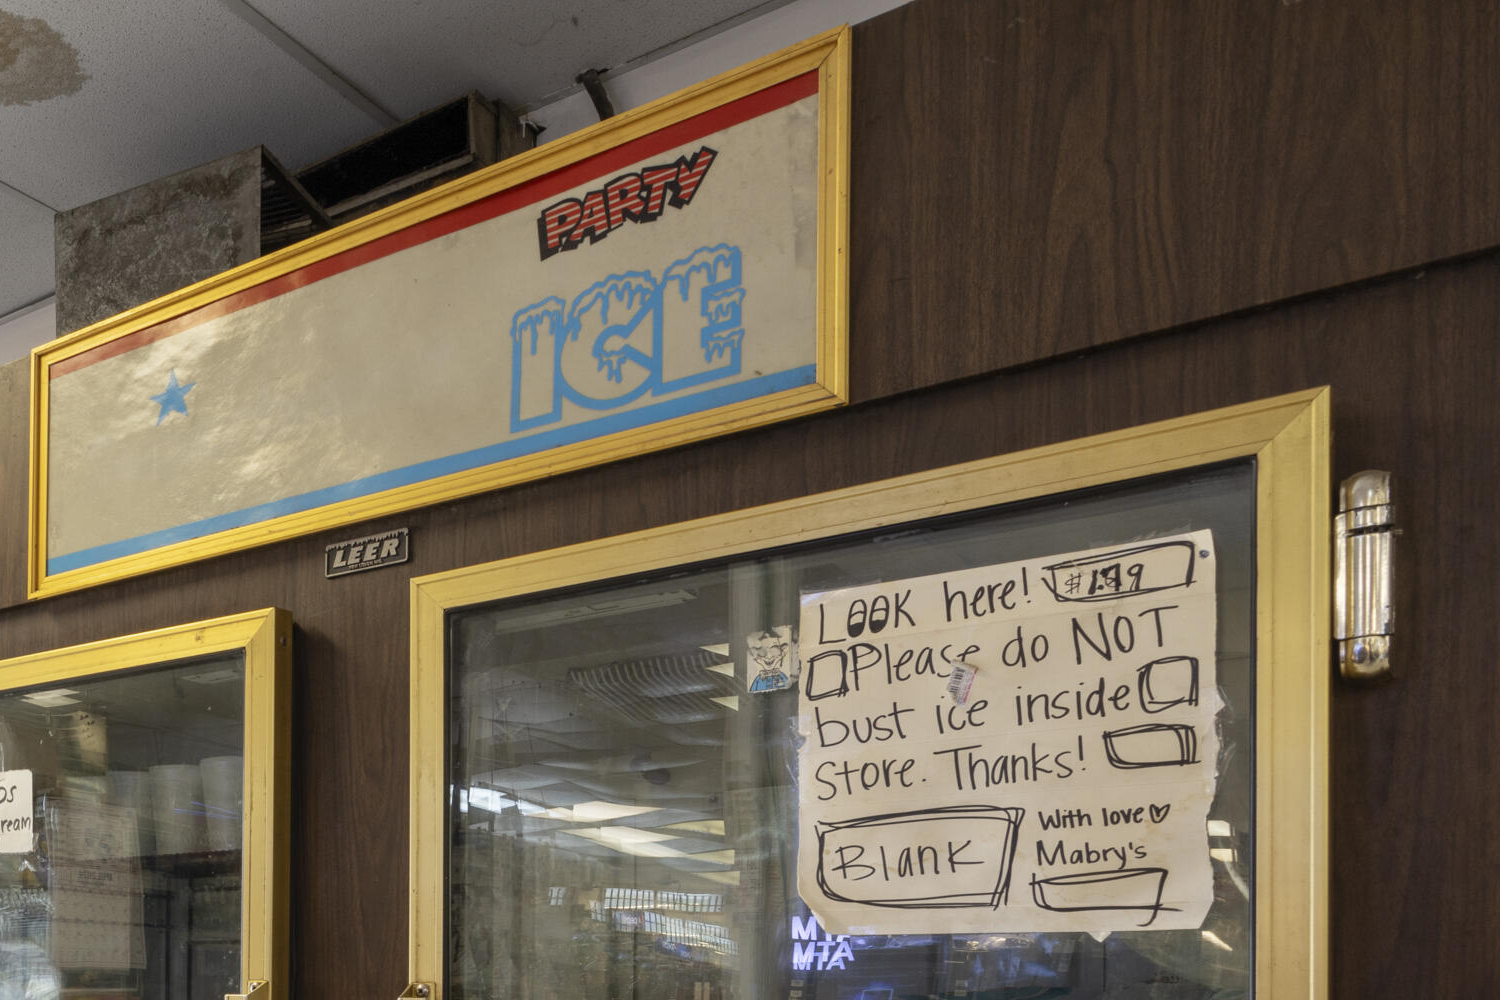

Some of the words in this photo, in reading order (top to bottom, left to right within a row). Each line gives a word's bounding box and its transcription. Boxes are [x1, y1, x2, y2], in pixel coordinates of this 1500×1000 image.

[537, 146, 718, 261] PARTY
[510, 243, 746, 433] ICE
[332, 538, 399, 569] LEER
[818, 590, 917, 646] LOOK
[943, 567, 1031, 622] here!
[849, 642, 981, 694] Please
[1002, 627, 1049, 668] do
[1072, 605, 1179, 665] NOT
[815, 701, 915, 748] bust
[936, 695, 989, 734] ice
[1016, 677, 1131, 726] inside
[933, 734, 1086, 791] Thanks!
[1102, 804, 1146, 827] love
[1036, 839, 1148, 870] Mabry's
